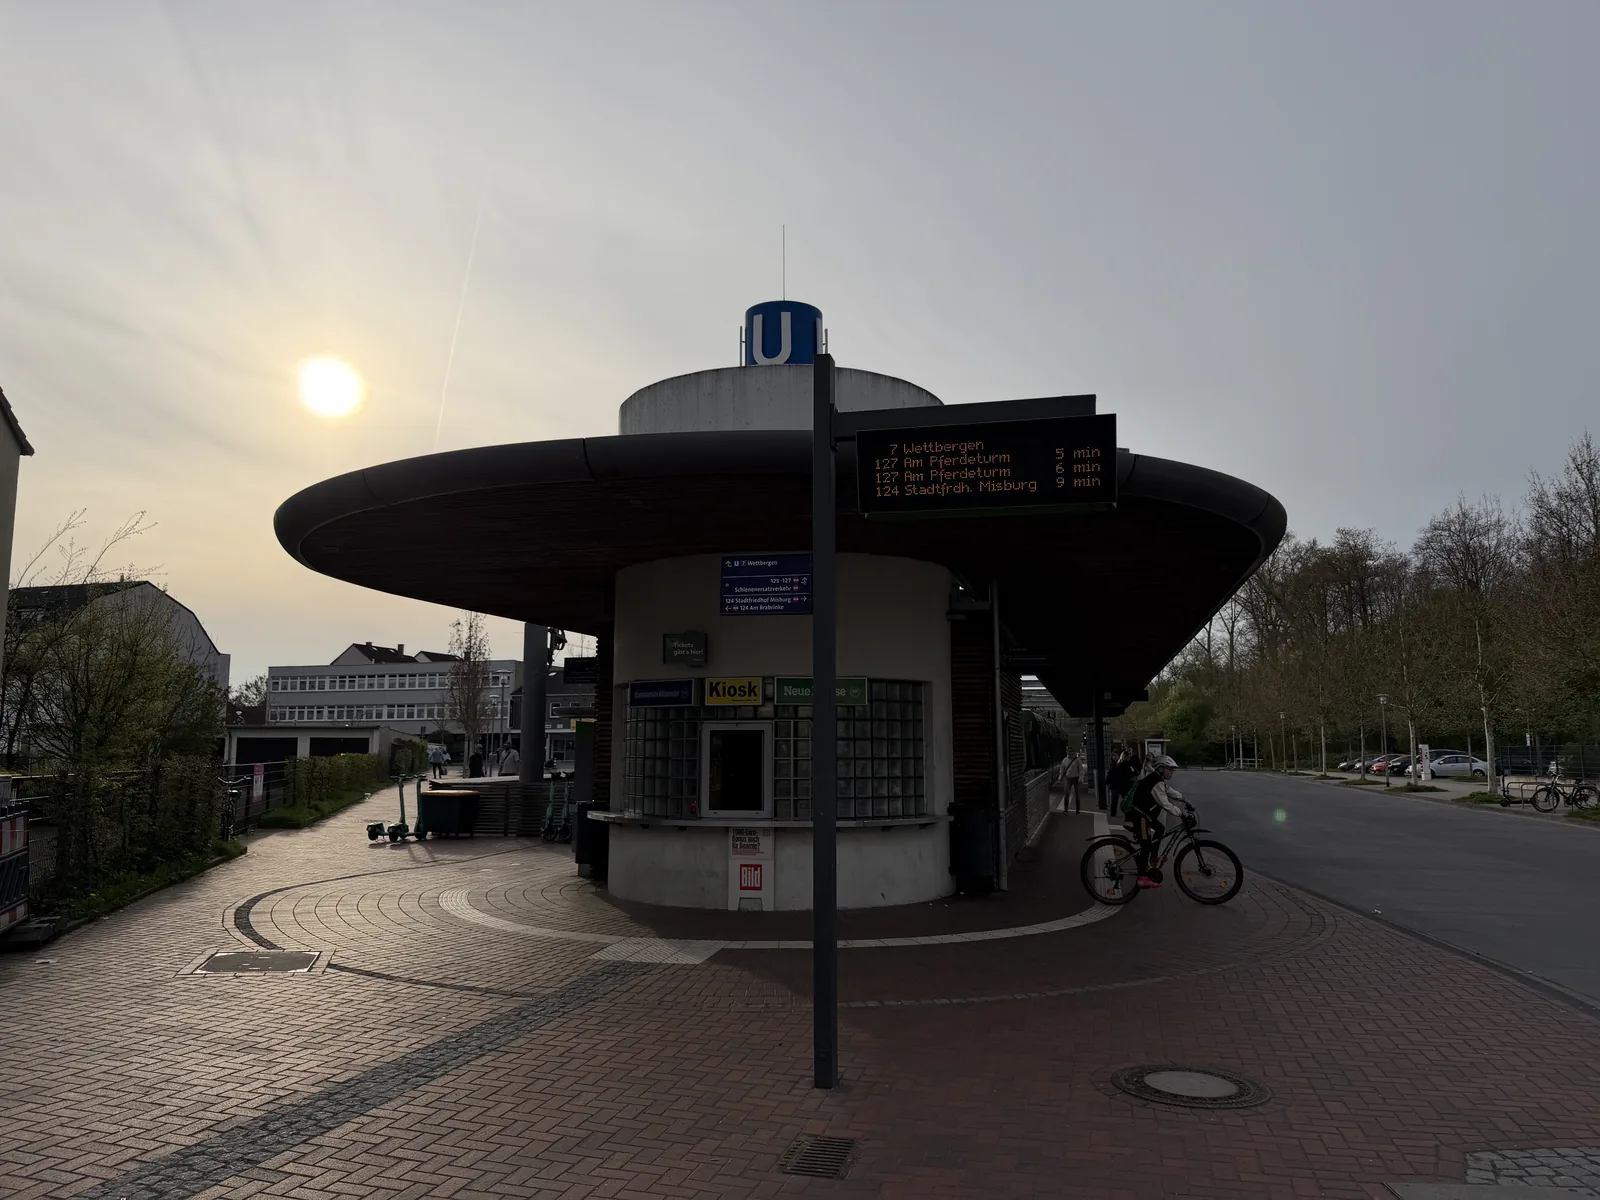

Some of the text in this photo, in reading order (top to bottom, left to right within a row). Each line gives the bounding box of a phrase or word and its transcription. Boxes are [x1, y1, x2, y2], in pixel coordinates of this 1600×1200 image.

[752, 311, 792, 365] U
[890, 441, 984, 455] 7 Wettbergen
[1055, 447, 1101, 460] 5 min
[875, 454, 1011, 469] 127 Am Pferdeturm
[1055, 462, 1101, 474] 6 min
[875, 468, 1011, 484] 127 Am Pferdeturm
[1056, 476, 1101, 489] 9 min
[876, 479, 1037, 498] 124 Stadtfrdh. Misburg
[747, 559, 778, 567] Wettbergen
[734, 585, 792, 593] Schienenersatzverkehr
[673, 641, 694, 649] Tickets
[673, 648, 689, 656] gibt's
[708, 681, 758, 698] Kiosk
[783, 685, 811, 696] Neue
[741, 866, 761, 888] Bild
